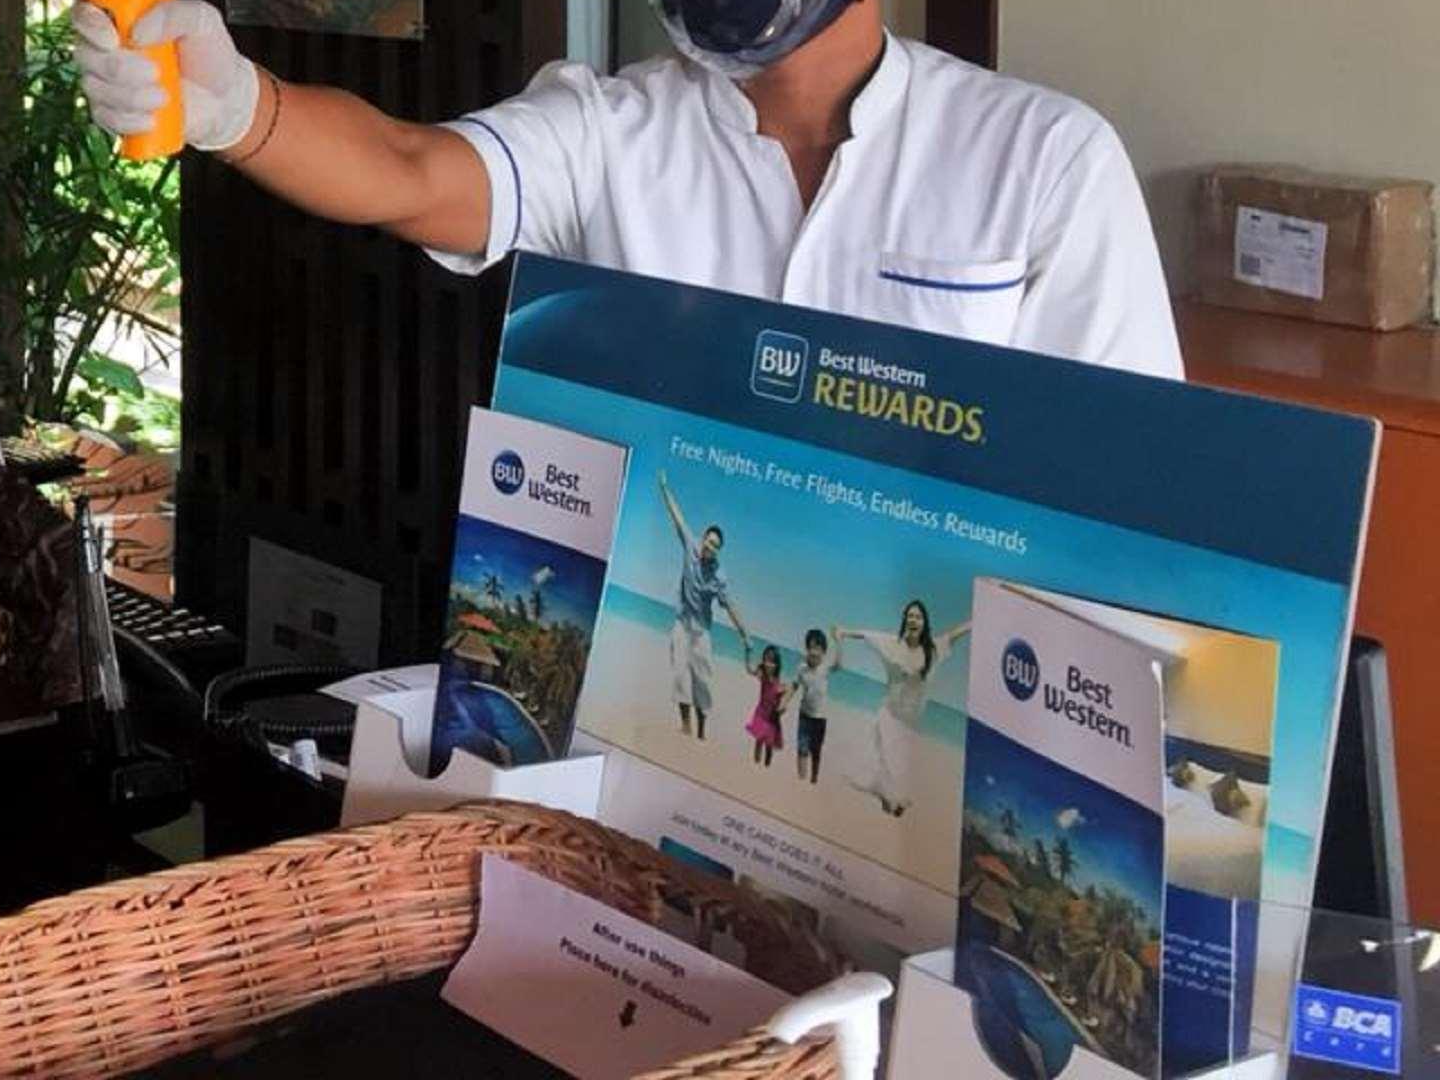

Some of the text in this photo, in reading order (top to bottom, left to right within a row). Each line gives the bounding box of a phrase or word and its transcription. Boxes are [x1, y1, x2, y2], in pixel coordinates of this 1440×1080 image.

[760, 346, 801, 377] BW
[820, 348, 926, 386] Best Western
[814, 373, 984, 443] REWARDS
[494, 463, 522, 485] BW
[546, 464, 580, 491] Best
[528, 478, 591, 516] Western
[671, 436, 1028, 555] Free Nights, Free Flights, Endless Rewards
[1006, 654, 1037, 688] BW
[1067, 665, 1112, 709] Best
[1044, 683, 1132, 748] Western
[560, 936, 591, 962] Place
[593, 954, 619, 978] here
[624, 940, 646, 958] use
[1332, 1006, 1392, 1038] BCA
